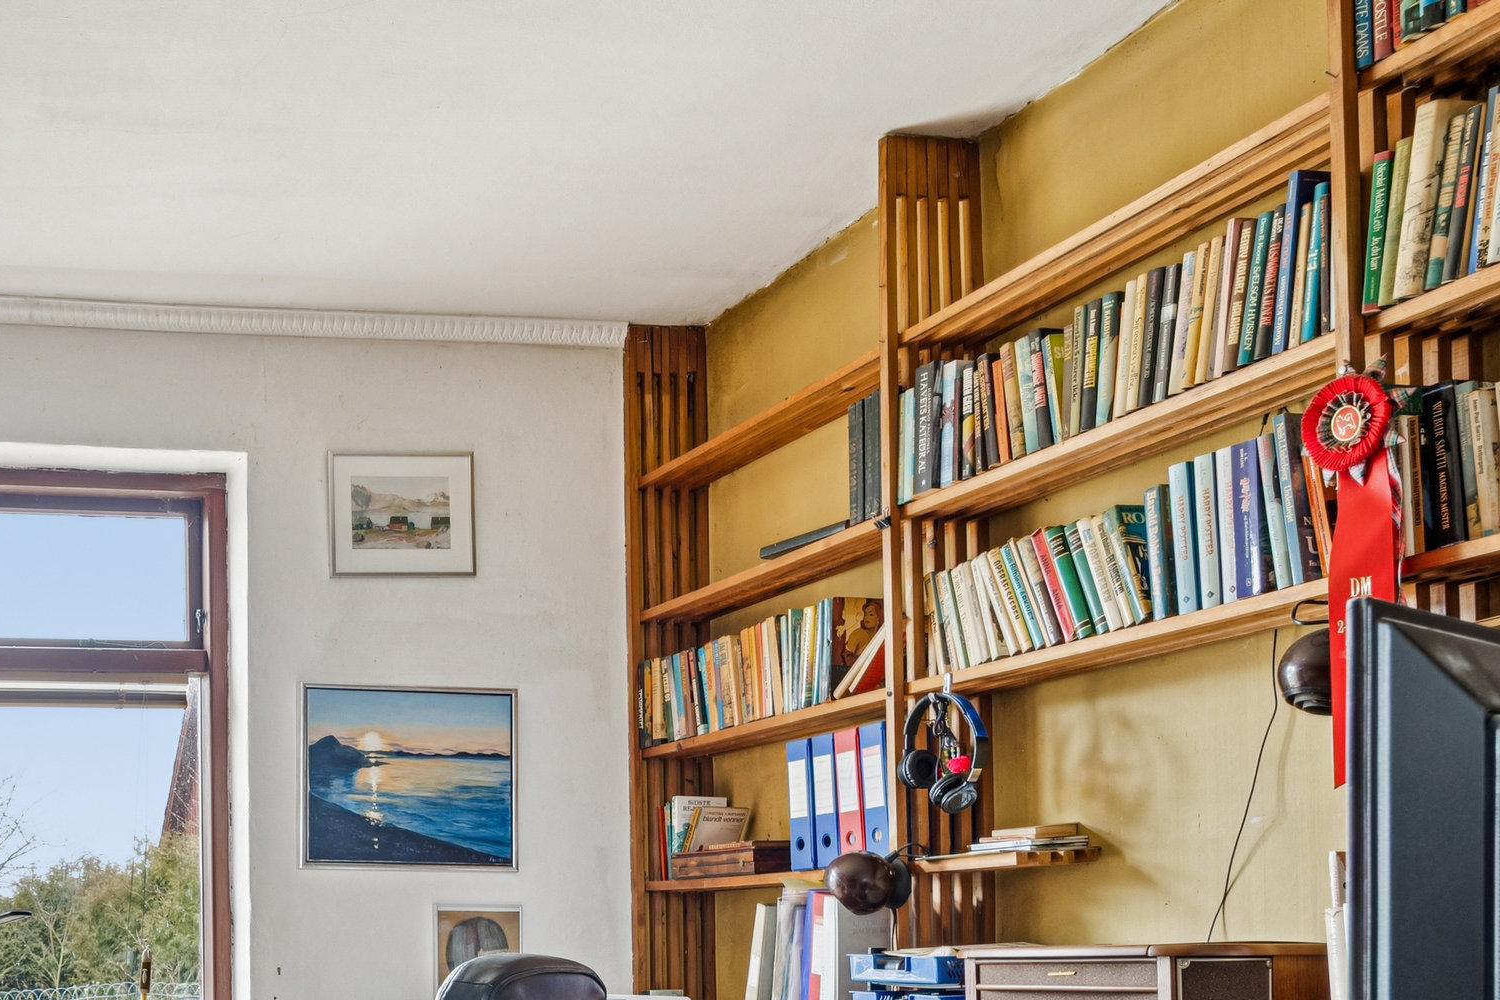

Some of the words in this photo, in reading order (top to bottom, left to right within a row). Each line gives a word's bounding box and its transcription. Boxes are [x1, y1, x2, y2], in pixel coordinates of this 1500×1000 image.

[1356, 22, 1368, 59] DANS
[1258, 217, 1266, 235] Dean
[1249, 265, 1261, 307] SÆLSOM
[1228, 301, 1242, 345] KALAHARI
[1243, 308, 1255, 350] HVISKEN
[1274, 314, 1284, 346] Monica
[919, 372, 928, 414] HAVETS
[1431, 400, 1444, 436] WILBUR
[918, 417, 928, 474] KATEDRAL
[1434, 439, 1446, 469] SMITH
[1202, 487, 1211, 518] HARRY
[1438, 471, 1447, 502] MAGIENS
[1146, 490, 1158, 526] Harold
[1177, 495, 1185, 523] HARRY
[1439, 503, 1449, 530] MESTER
[1204, 519, 1213, 556] POTTER
[1039, 553, 1052, 575] ANNA
[1051, 588, 1064, 611] ANNA
[1350, 576, 1373, 597] DM
[1018, 590, 1034, 621] ARKIVET
